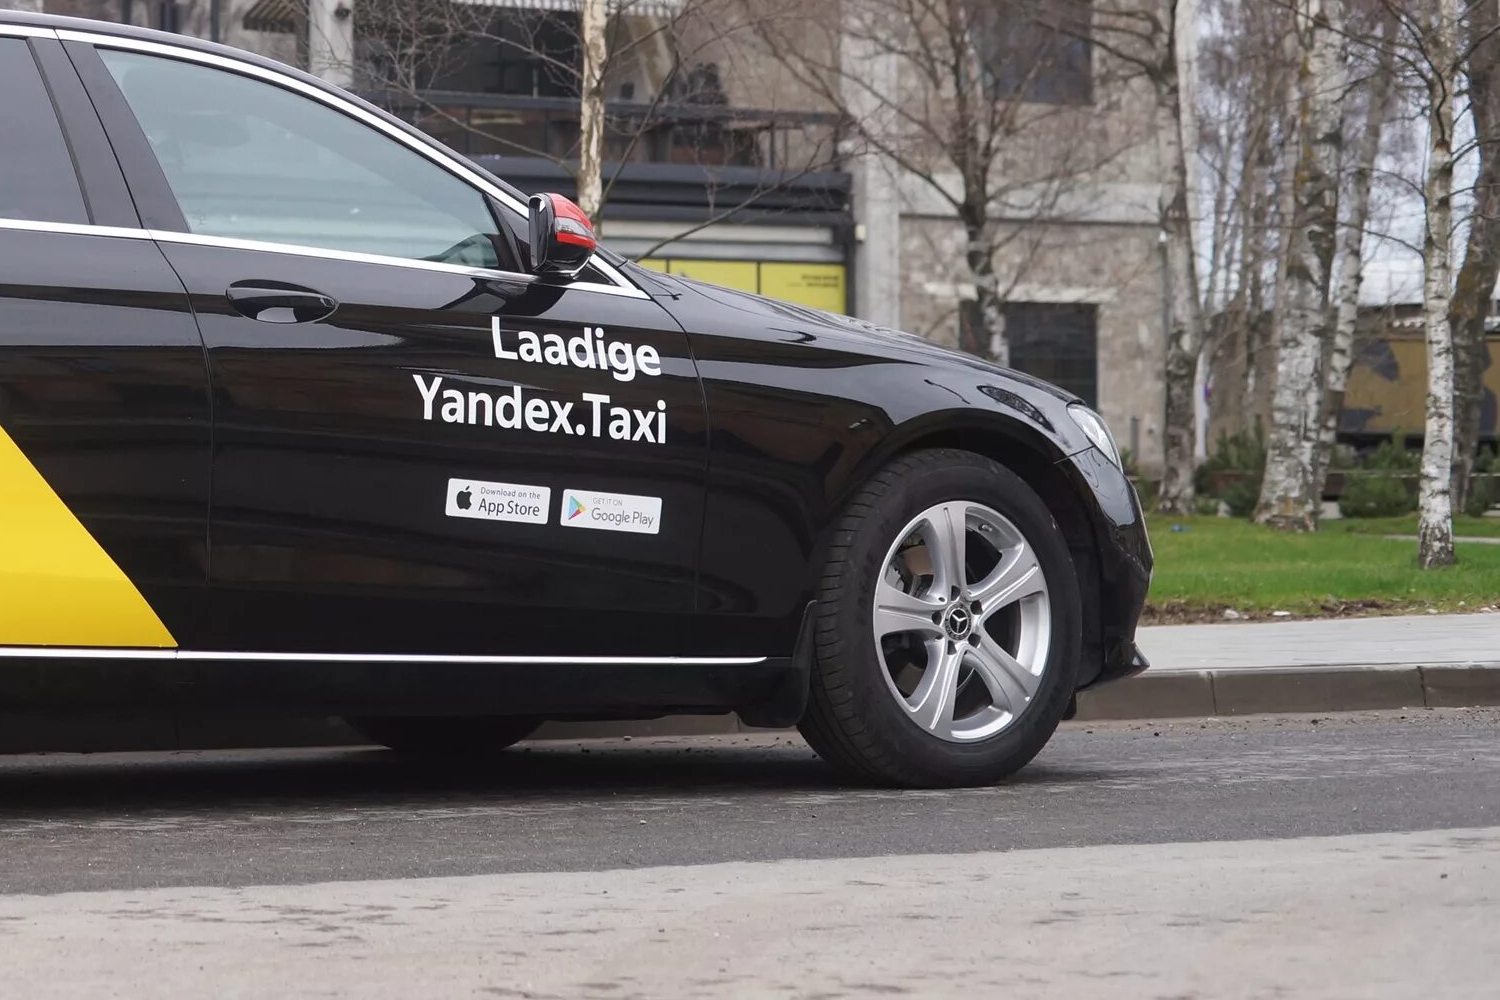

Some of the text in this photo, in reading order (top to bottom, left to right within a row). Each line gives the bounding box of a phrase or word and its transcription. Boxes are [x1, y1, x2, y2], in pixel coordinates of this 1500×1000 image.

[491, 316, 661, 382] Laadige
[412, 374, 667, 444] Yandex.Taxi
[480, 487, 516, 498] Download
[529, 490, 541, 499] the
[592, 497, 605, 505] GET
[478, 498, 540, 517] App Store
[591, 507, 654, 528] Google Play
